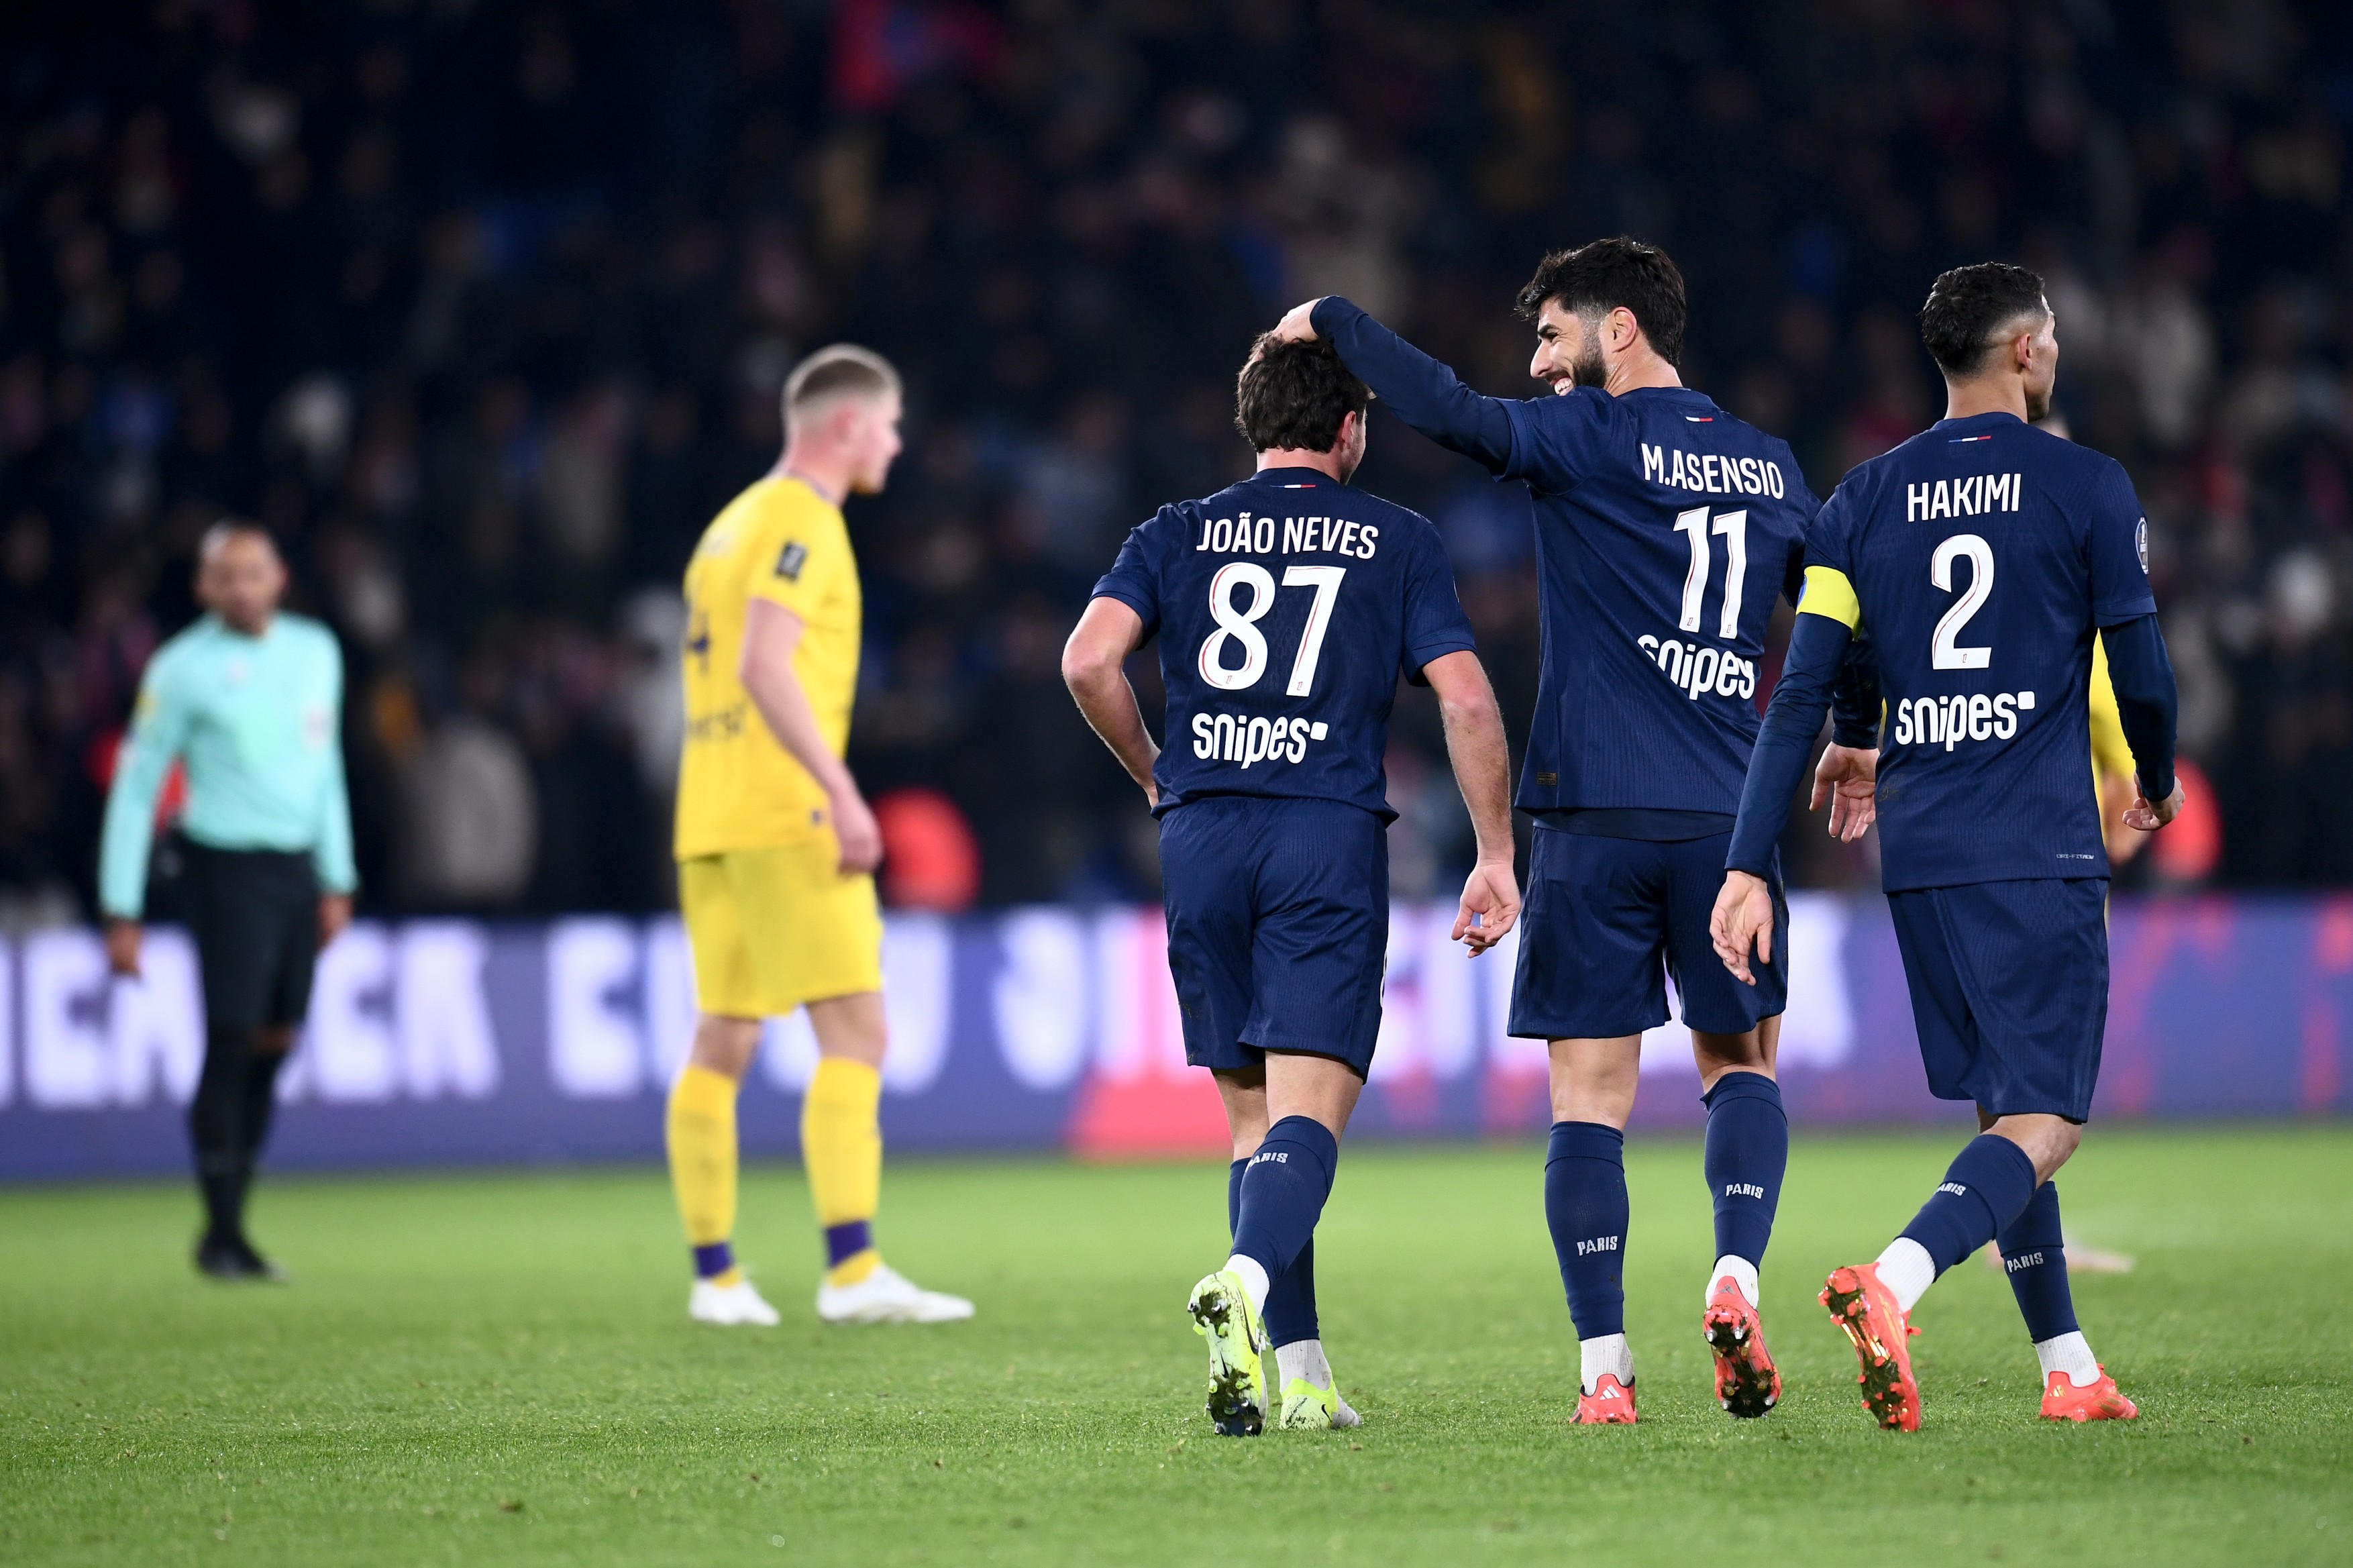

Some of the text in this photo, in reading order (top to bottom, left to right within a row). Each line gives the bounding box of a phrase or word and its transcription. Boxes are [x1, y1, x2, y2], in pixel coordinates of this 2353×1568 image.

[1641, 443, 1784, 500] M.ASENSIO
[1907, 473, 2022, 522] HAKIMI
[1196, 512, 1379, 560] JOÃO NEVES
[1673, 505, 1747, 639] 11
[1931, 534, 1994, 670] 2
[1198, 562, 1347, 697] 87
[1192, 713, 1308, 769] snipes
[1895, 692, 2017, 751] snipes
[1726, 1183, 1764, 1200] PARIS
[1936, 1182, 1967, 1196] ARIS
[1577, 1235, 1618, 1256] PARIS
[2007, 1251, 2044, 1273] PARIS
